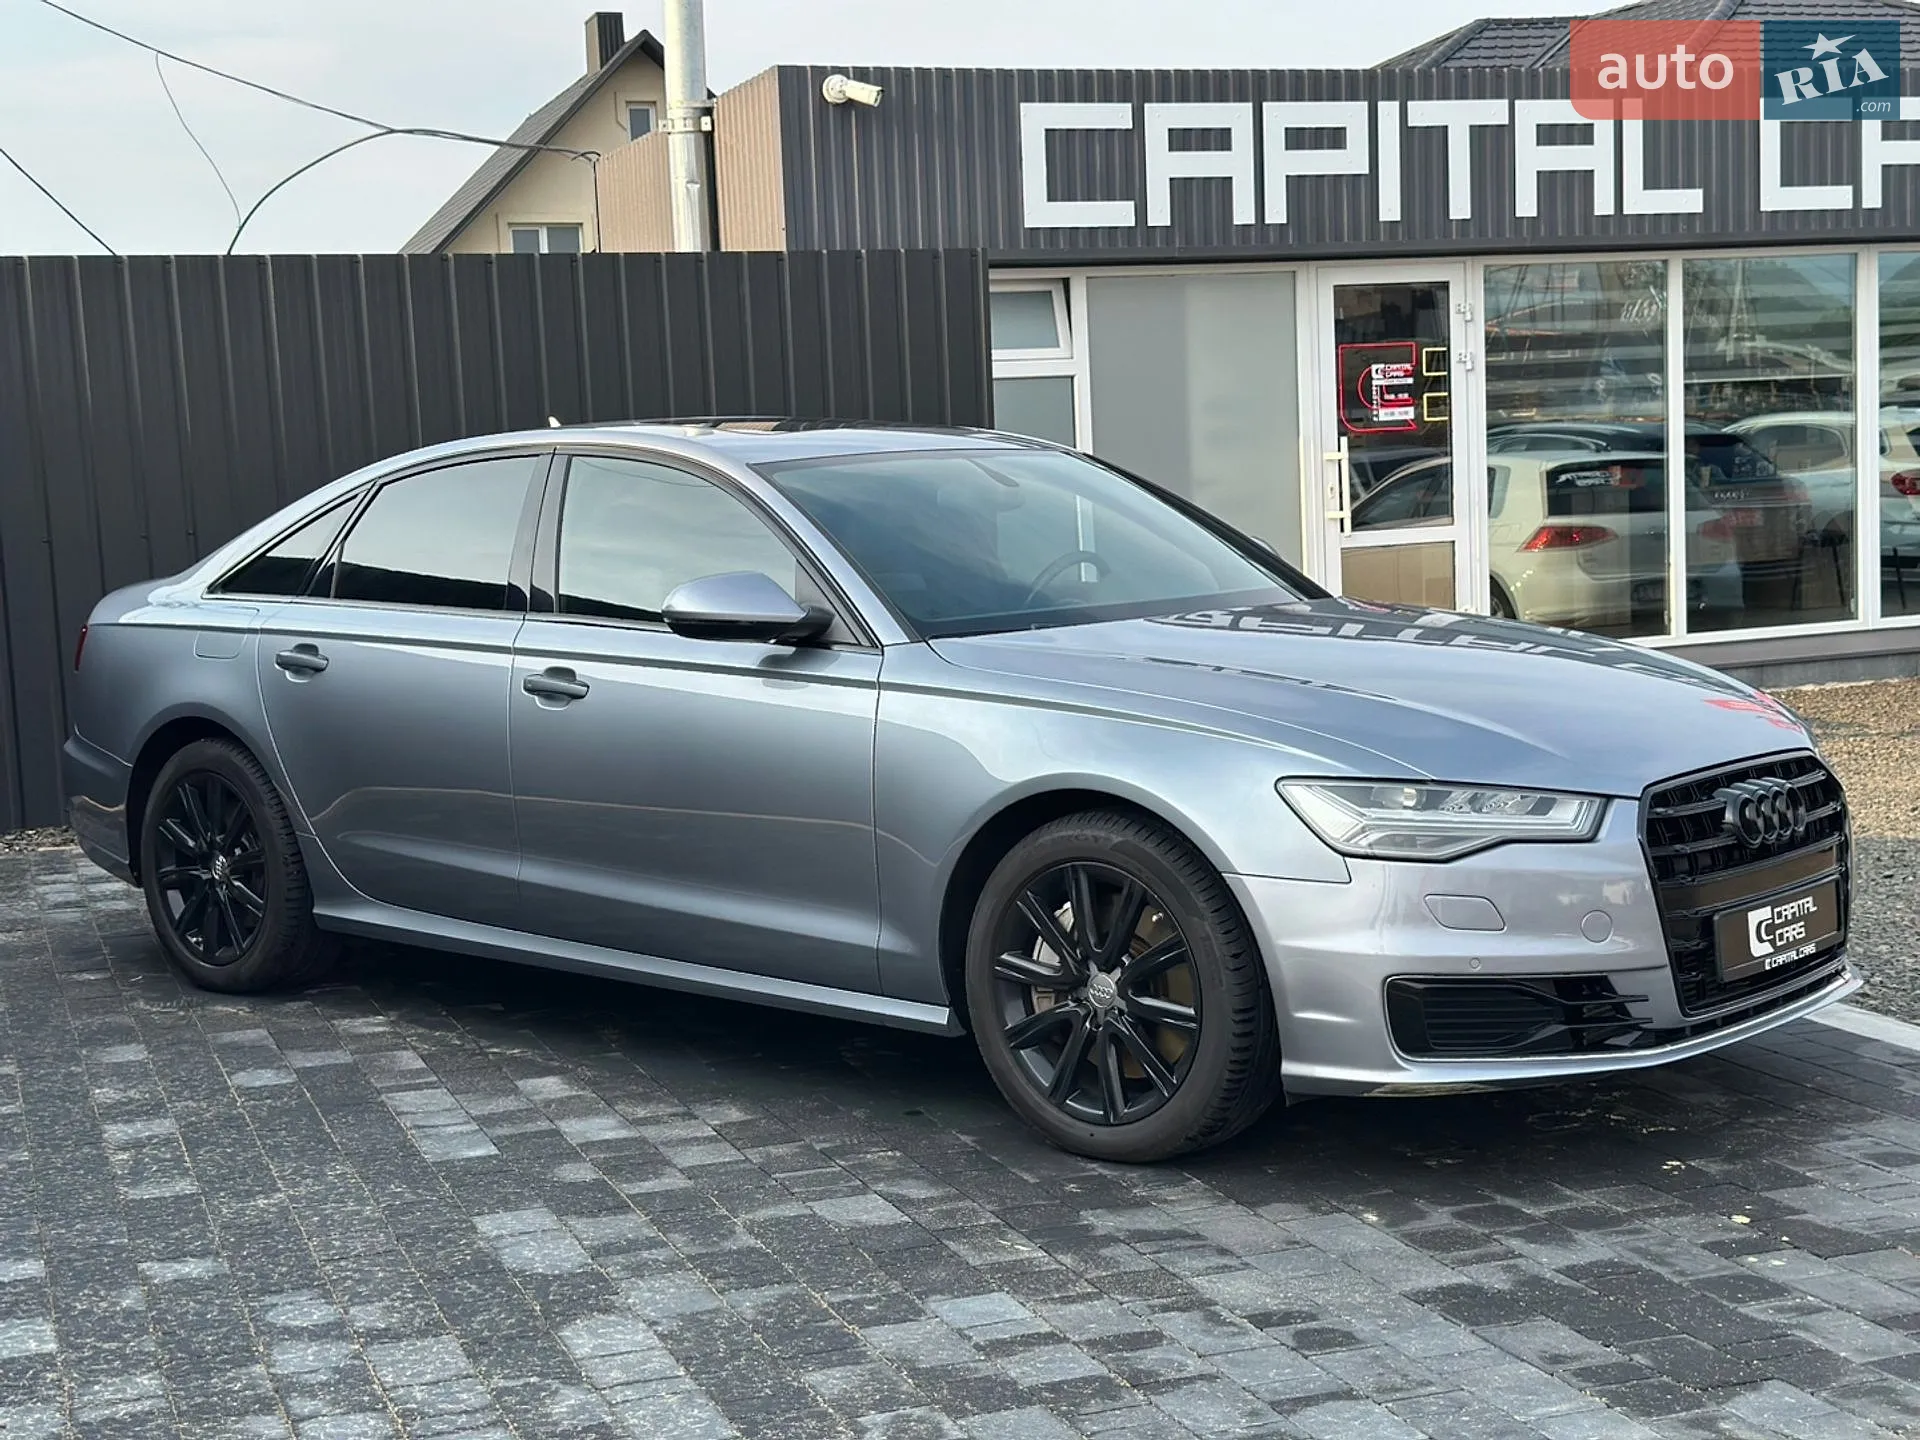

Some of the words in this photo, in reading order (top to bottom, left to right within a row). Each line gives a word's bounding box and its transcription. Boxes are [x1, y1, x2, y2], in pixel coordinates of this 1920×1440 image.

[1019, 96, 1705, 229] CAPITAL
[1773, 896, 1818, 924] CAPITAL
[1775, 921, 1806, 947] CARS
[1771, 950, 1799, 968] CAPITAL
[1799, 943, 1817, 959] CARS
